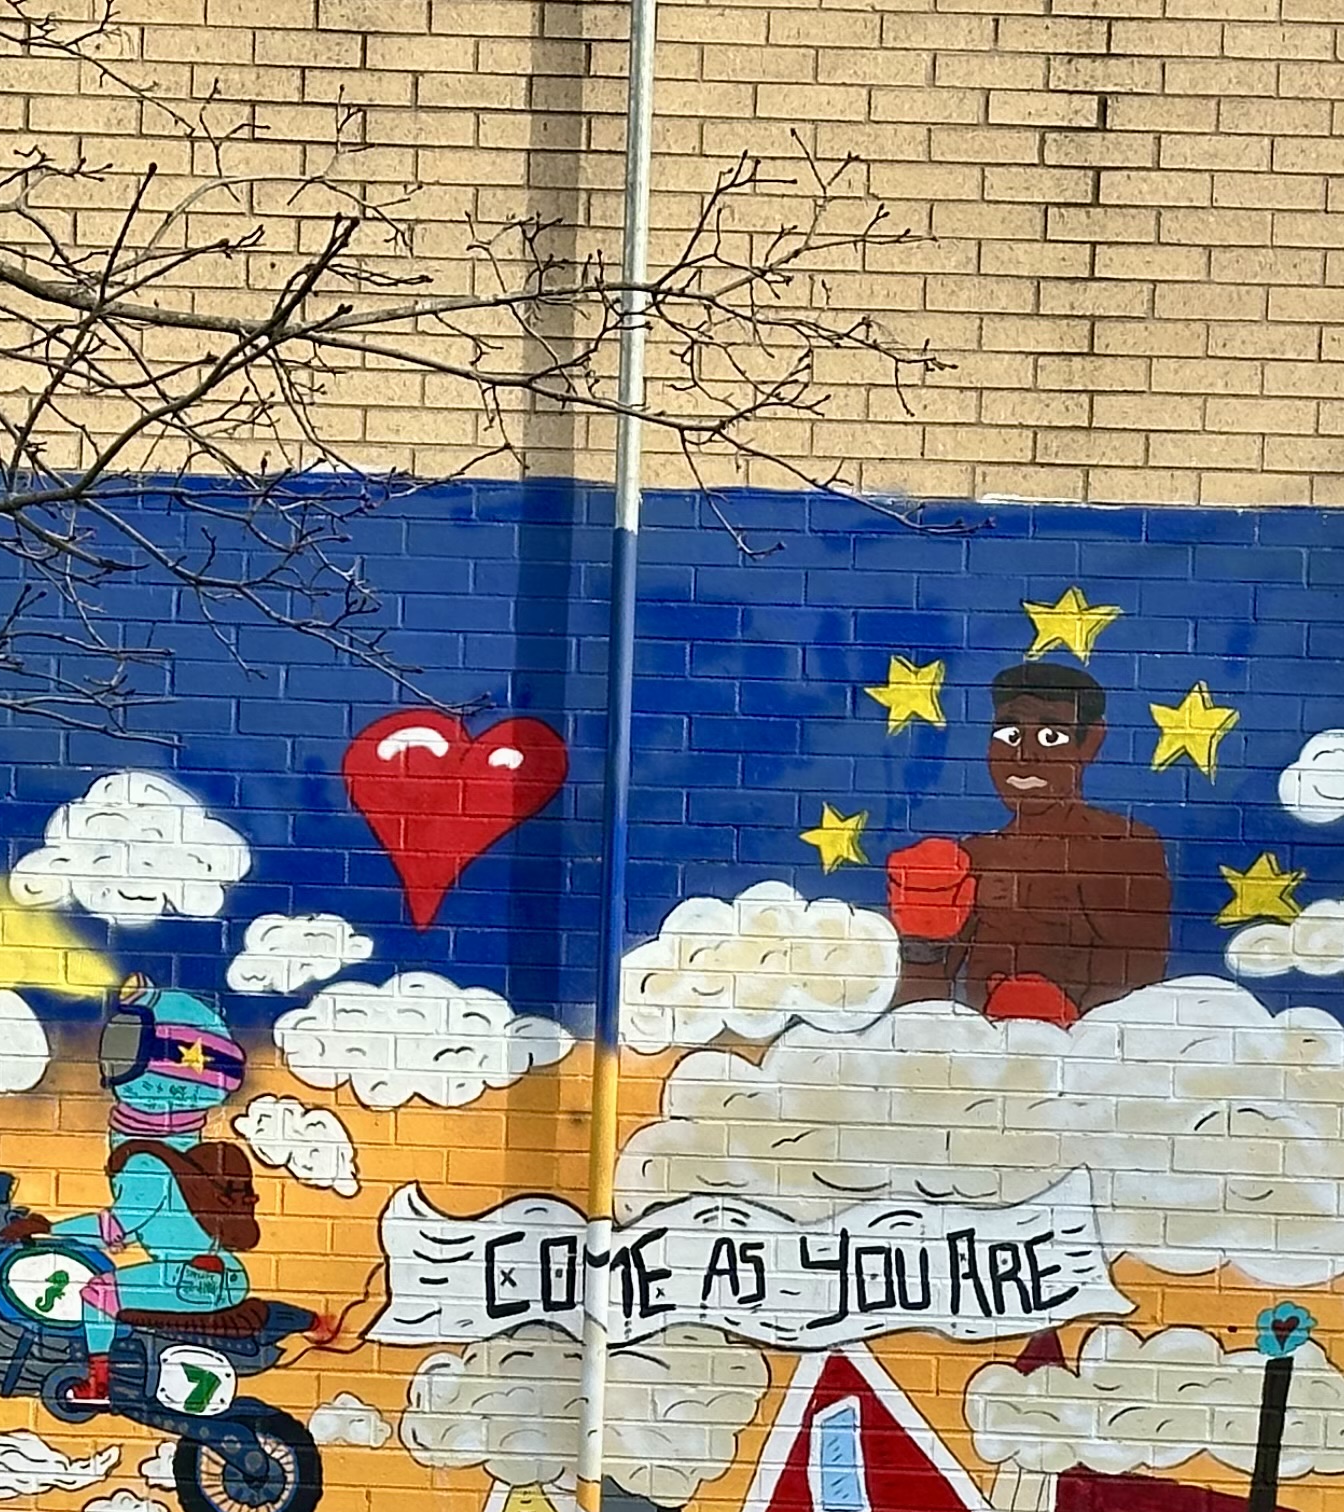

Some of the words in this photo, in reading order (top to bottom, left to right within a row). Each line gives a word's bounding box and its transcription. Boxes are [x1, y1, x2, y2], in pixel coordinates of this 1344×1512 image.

[485, 1227, 677, 1319] COME
[703, 1237, 766, 1305] AS
[801, 1228, 931, 1330] YOU
[948, 1228, 1078, 1319] ARE
